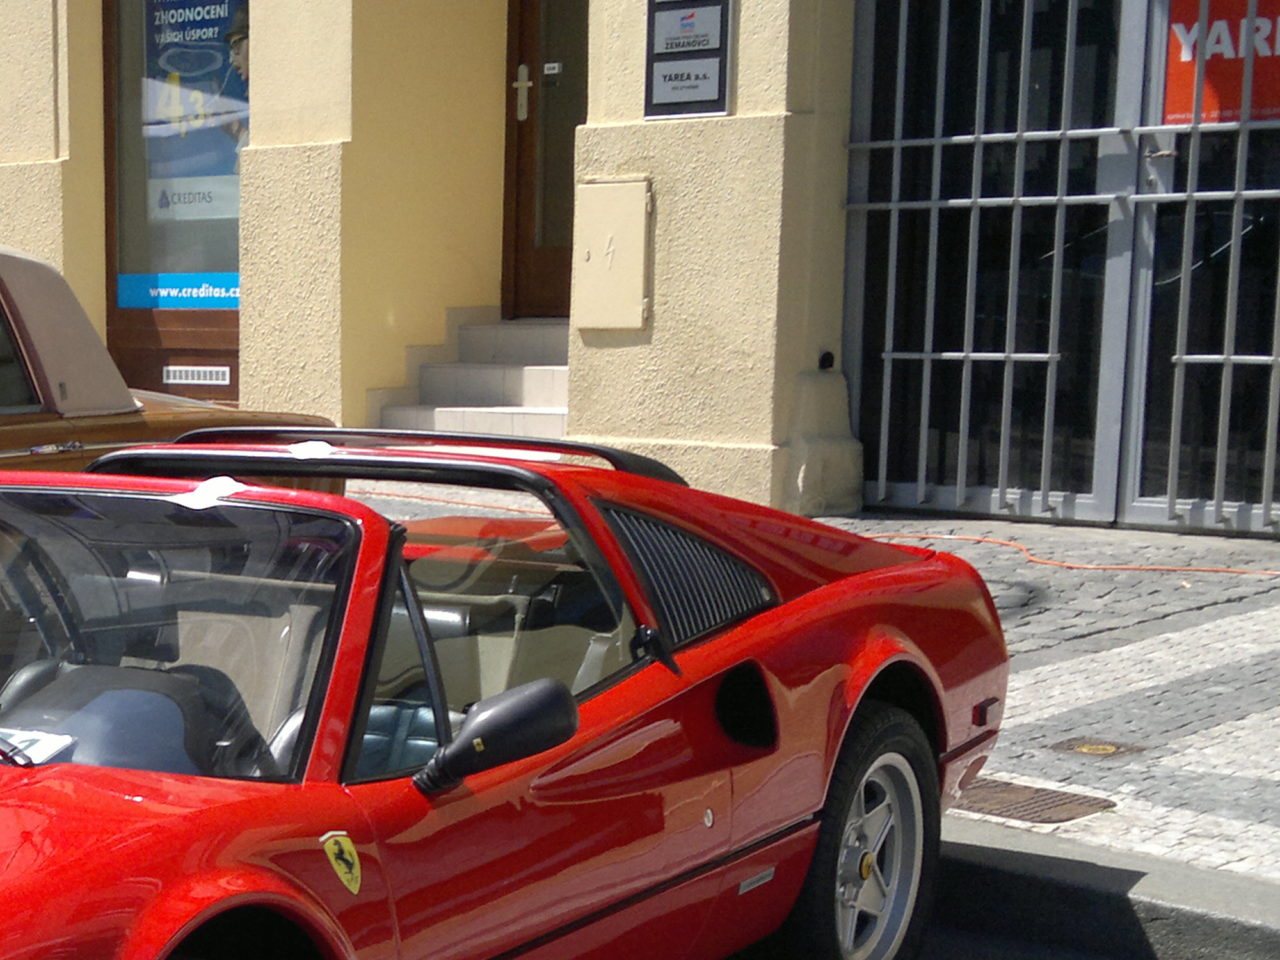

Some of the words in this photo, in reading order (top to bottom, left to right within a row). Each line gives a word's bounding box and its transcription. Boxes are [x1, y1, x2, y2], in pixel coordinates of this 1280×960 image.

[154, 0, 229, 25] ZHODNOCENÍ
[185, 27, 219, 41] ÚSPOR?
[665, 40, 710, 50] ZEMANOVCI
[663, 72, 691, 82] YAREA
[171, 191, 213, 205] CREDITAS
